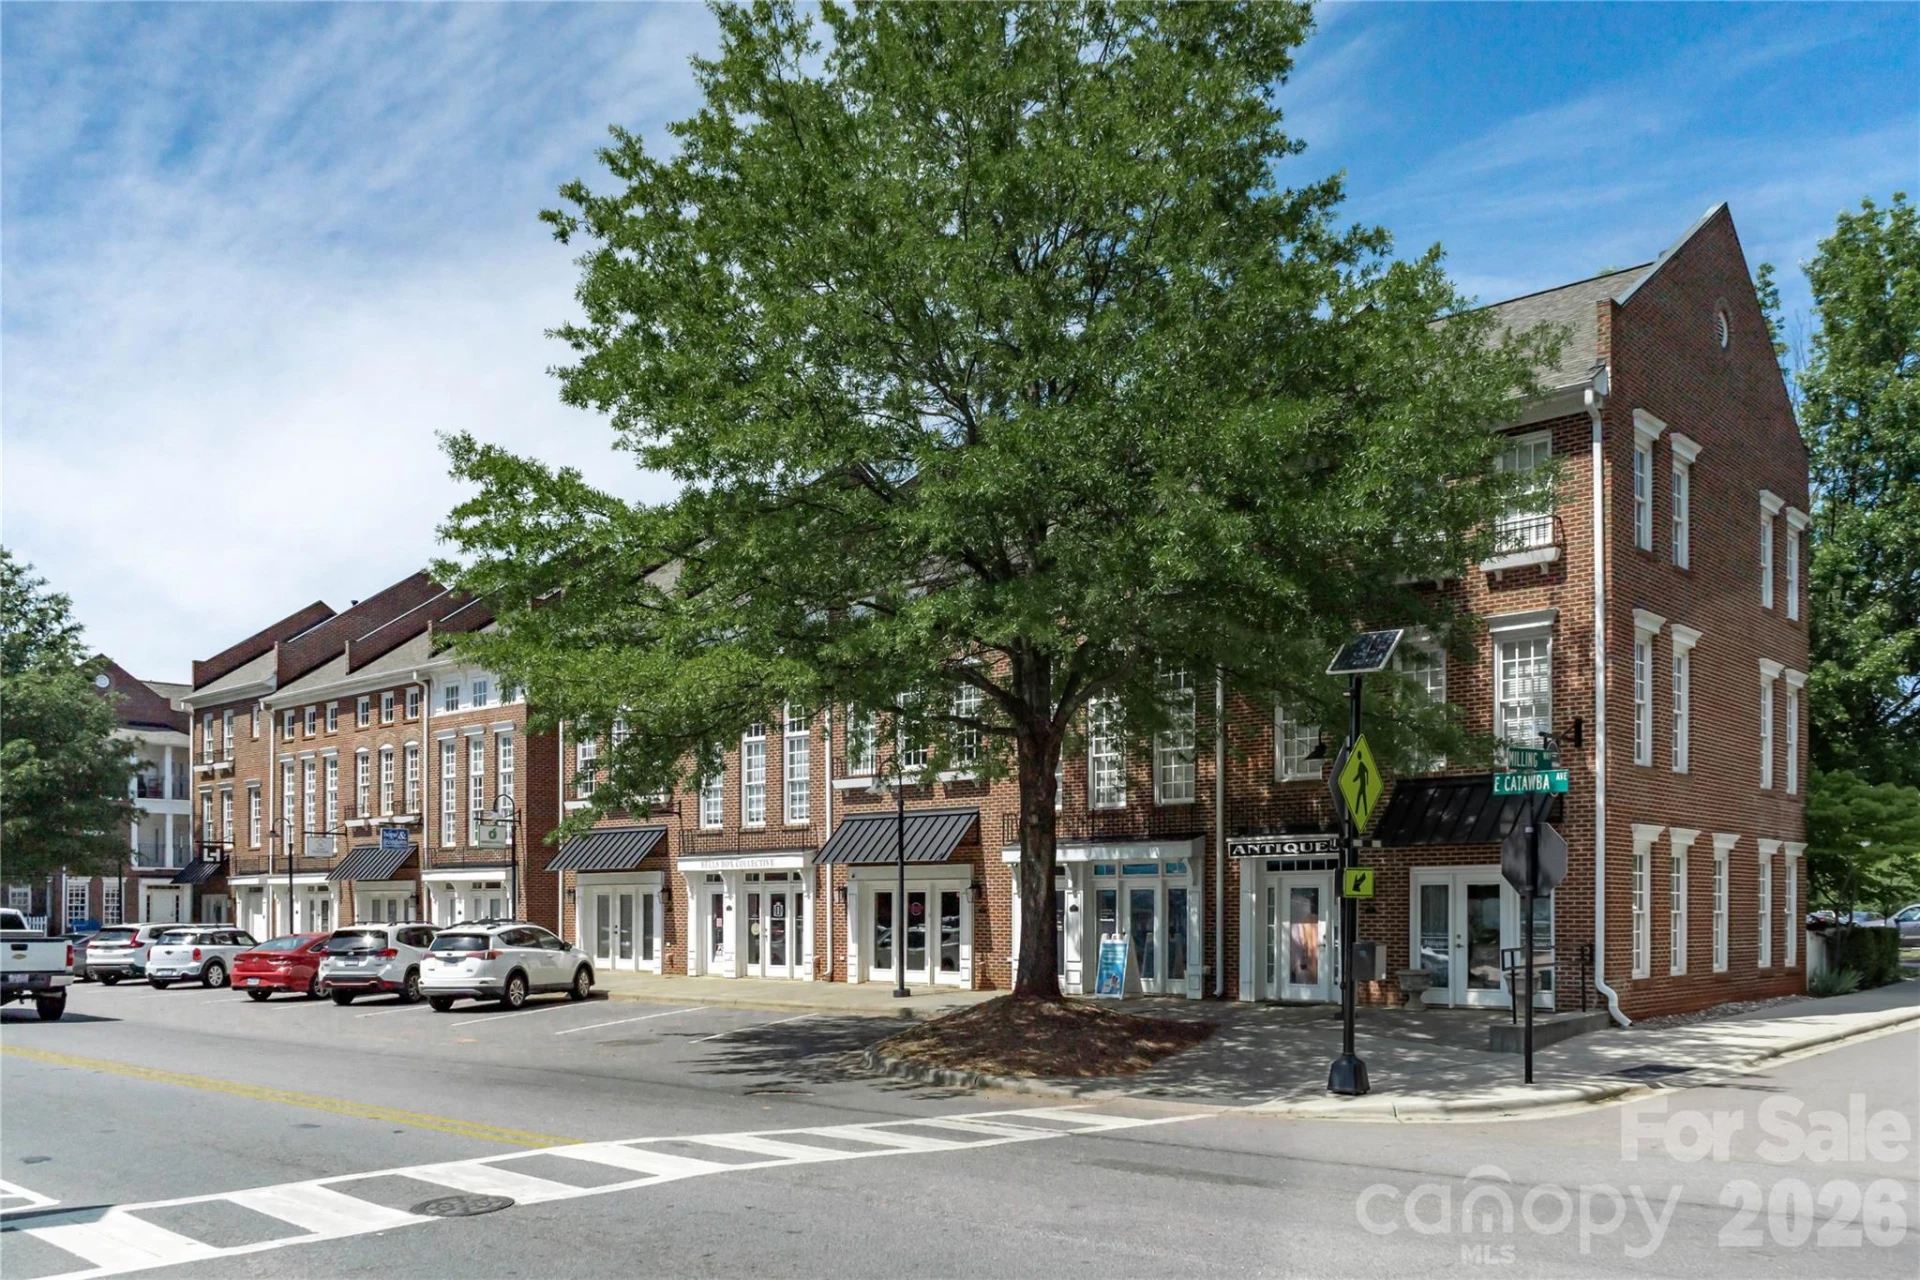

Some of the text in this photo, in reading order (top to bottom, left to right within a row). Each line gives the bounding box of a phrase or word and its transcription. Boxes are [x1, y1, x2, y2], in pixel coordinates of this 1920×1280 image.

[1508, 751, 1538, 768] MILLING
[1494, 772, 1568, 792] E CATAWBA AVE
[735, 859, 774, 868] COLLECTIVE
